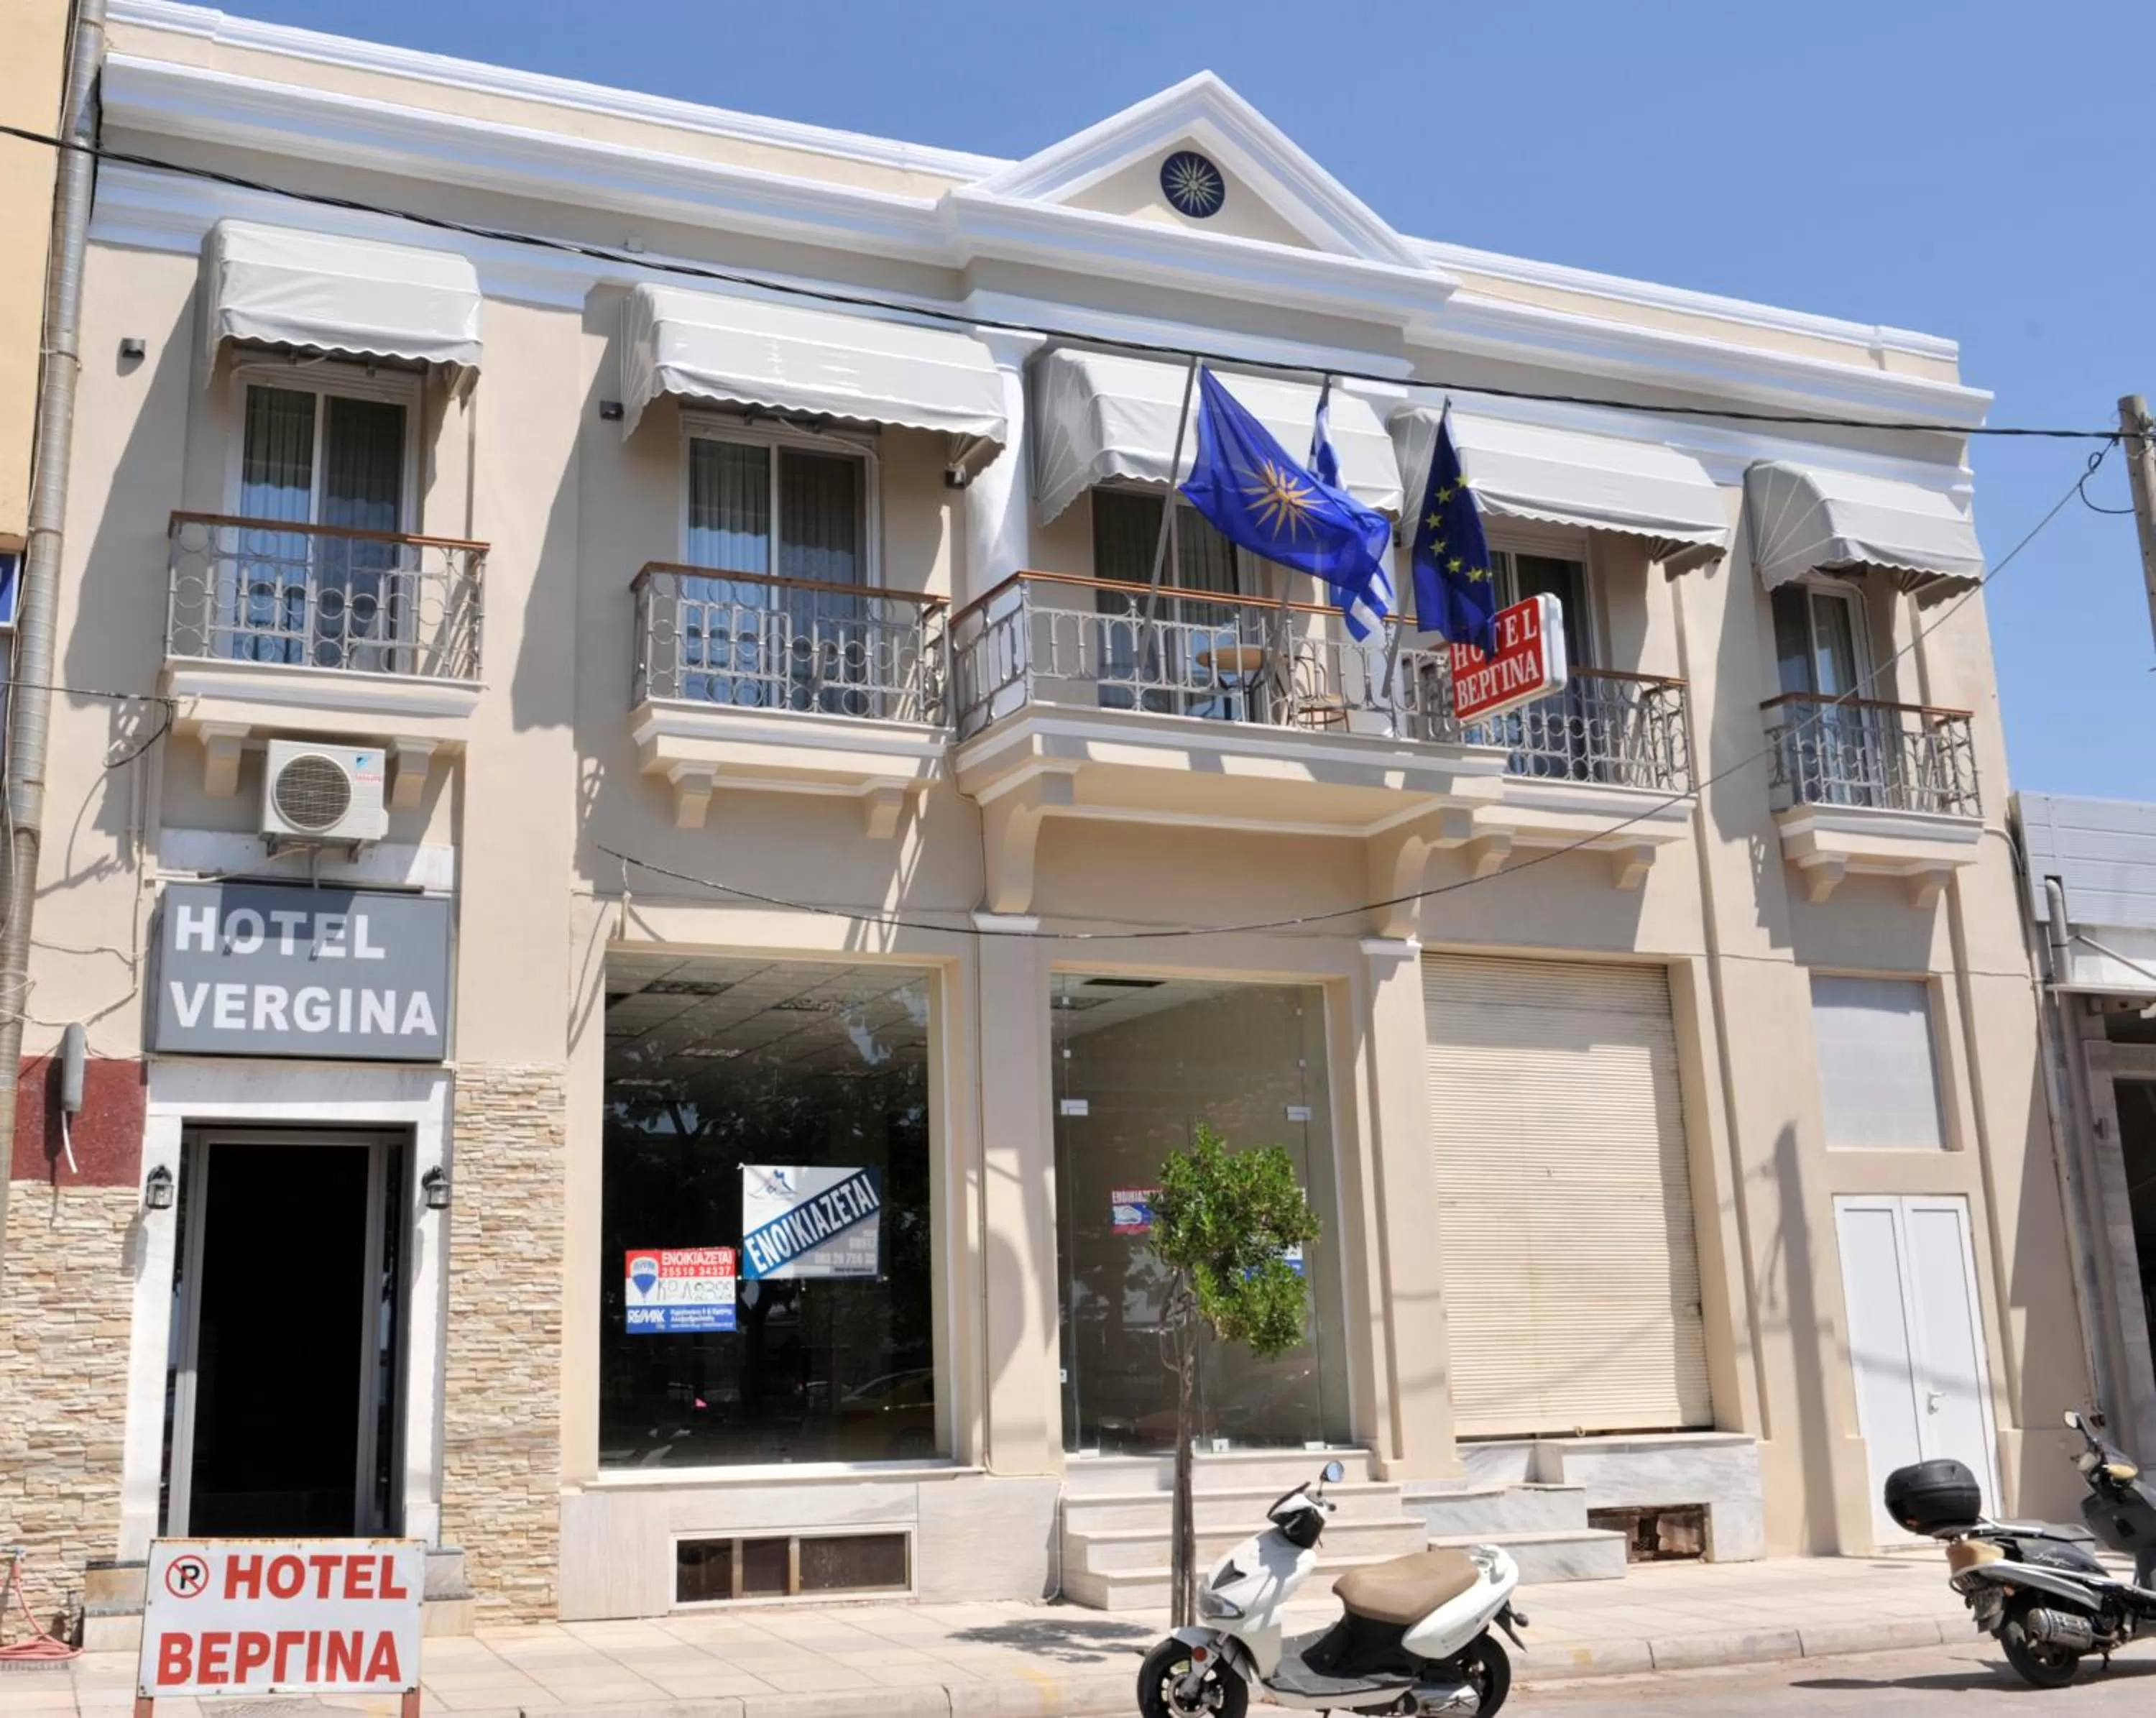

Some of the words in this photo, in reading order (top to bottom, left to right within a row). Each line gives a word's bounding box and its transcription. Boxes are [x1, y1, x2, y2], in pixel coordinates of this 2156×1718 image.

[1455, 649, 1540, 712] ΒΕΡΓΙΝΑ
[174, 904, 386, 960] HOTEL
[169, 980, 438, 1037] VERGINA
[744, 1173, 880, 1274] ΕΝΟΙΚΙΑΖΕΤΑΙ
[661, 1251, 733, 1266] ΕΝΟΙΚΙΑΖΕΤΑΙ
[224, 1554, 407, 1600] HOTEL
[157, 1630, 402, 1686] ΒΕΡΓΙΝΑ
